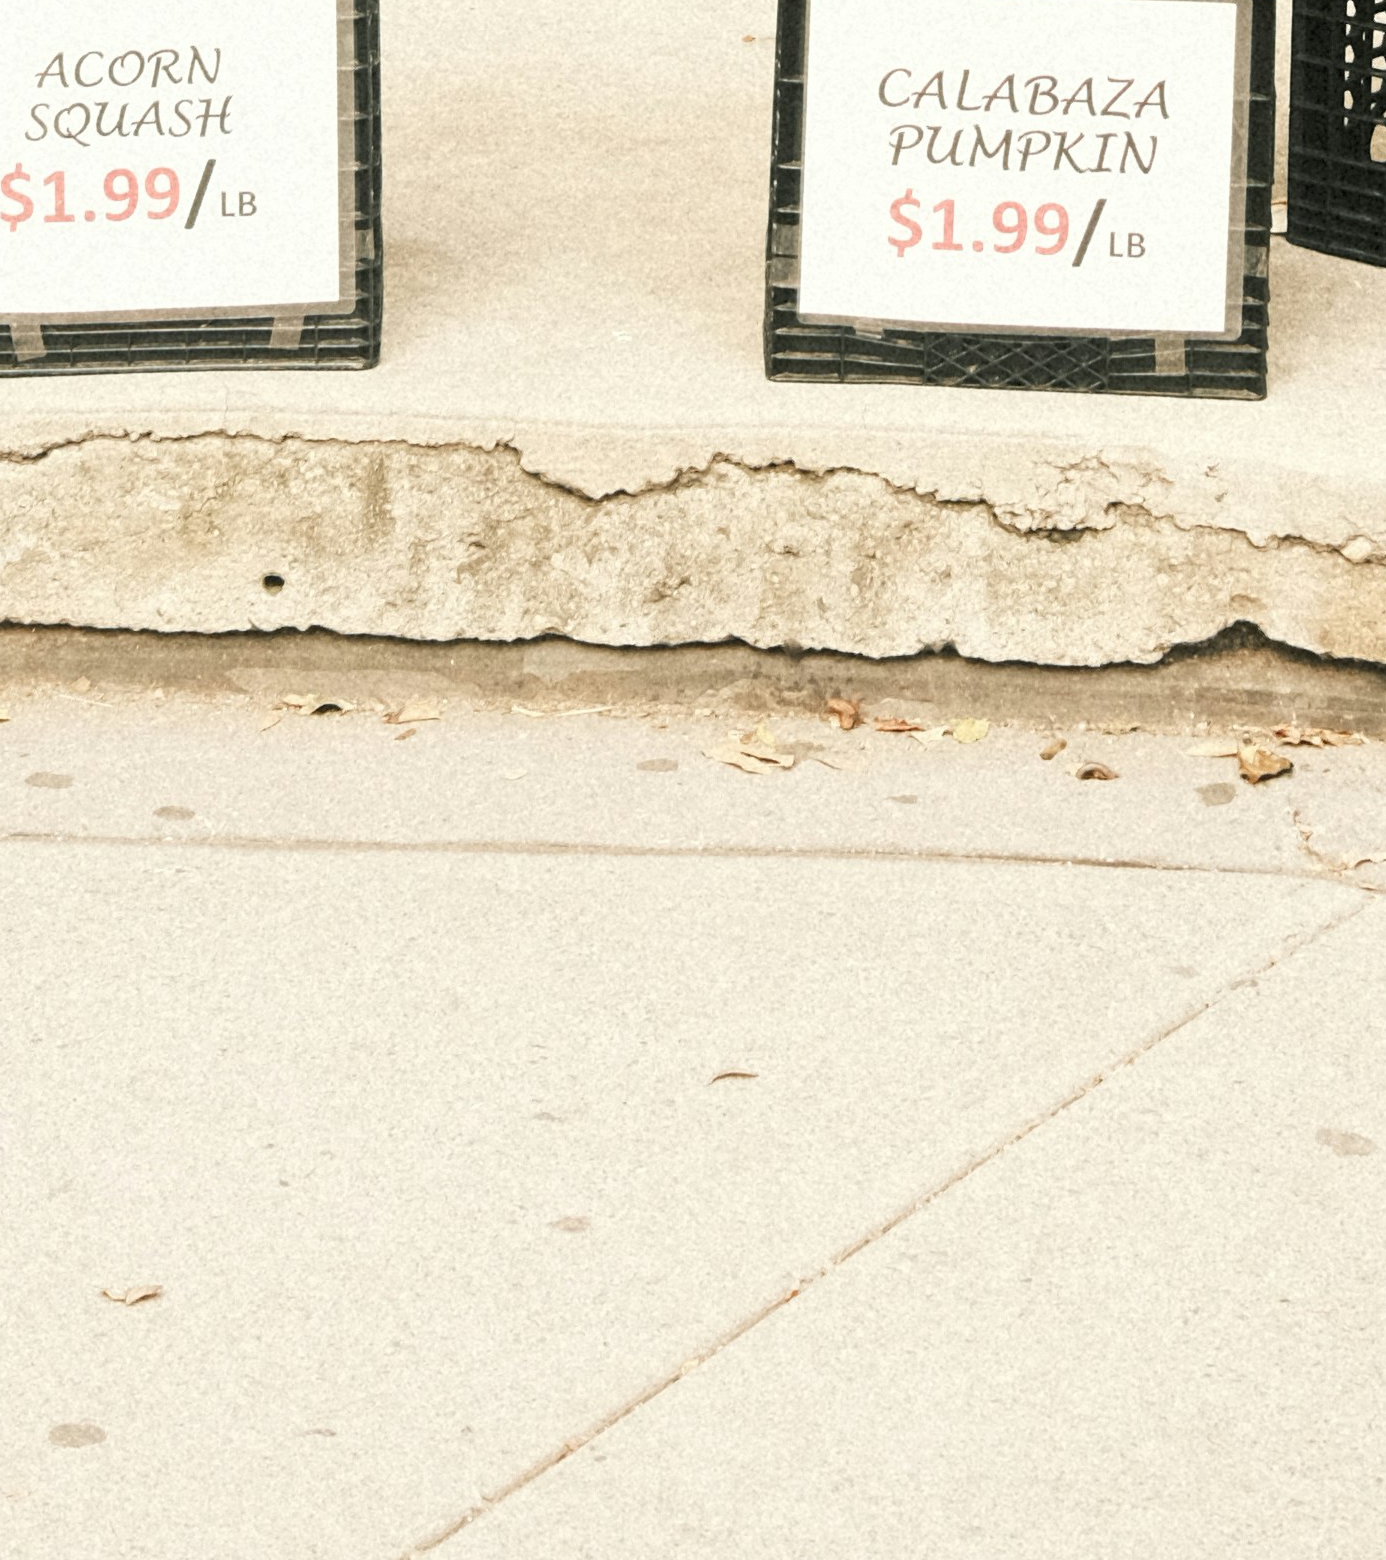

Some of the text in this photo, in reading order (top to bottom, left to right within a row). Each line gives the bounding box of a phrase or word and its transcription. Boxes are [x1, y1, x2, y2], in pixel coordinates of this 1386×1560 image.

[34, 45, 225, 93] ACORN
[875, 67, 1173, 120] CALABAZA
[22, 93, 236, 147] SQUASH
[886, 124, 1160, 178] PUMPKIN
